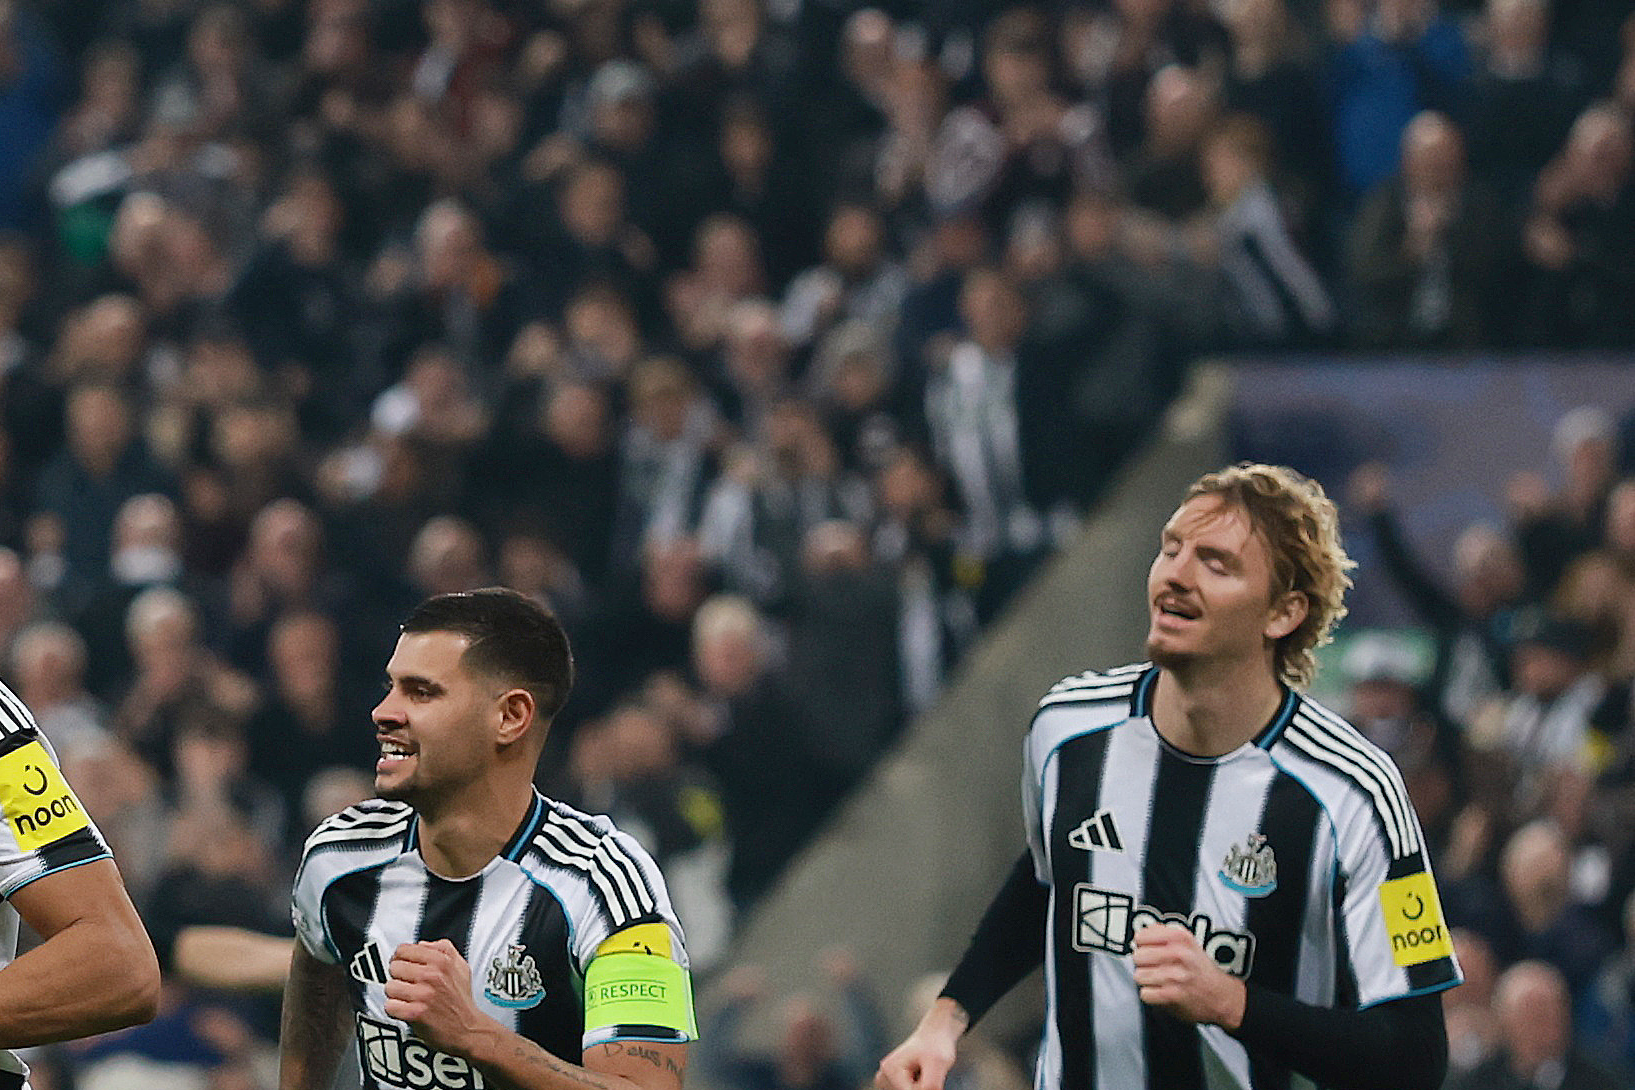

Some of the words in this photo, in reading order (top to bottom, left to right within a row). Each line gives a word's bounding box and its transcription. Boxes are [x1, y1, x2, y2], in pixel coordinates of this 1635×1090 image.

[14, 794, 79, 835] noon
[1131, 912, 1248, 975] la
[600, 983, 667, 1000] RESPECT
[404, 1044, 485, 1090] sel
